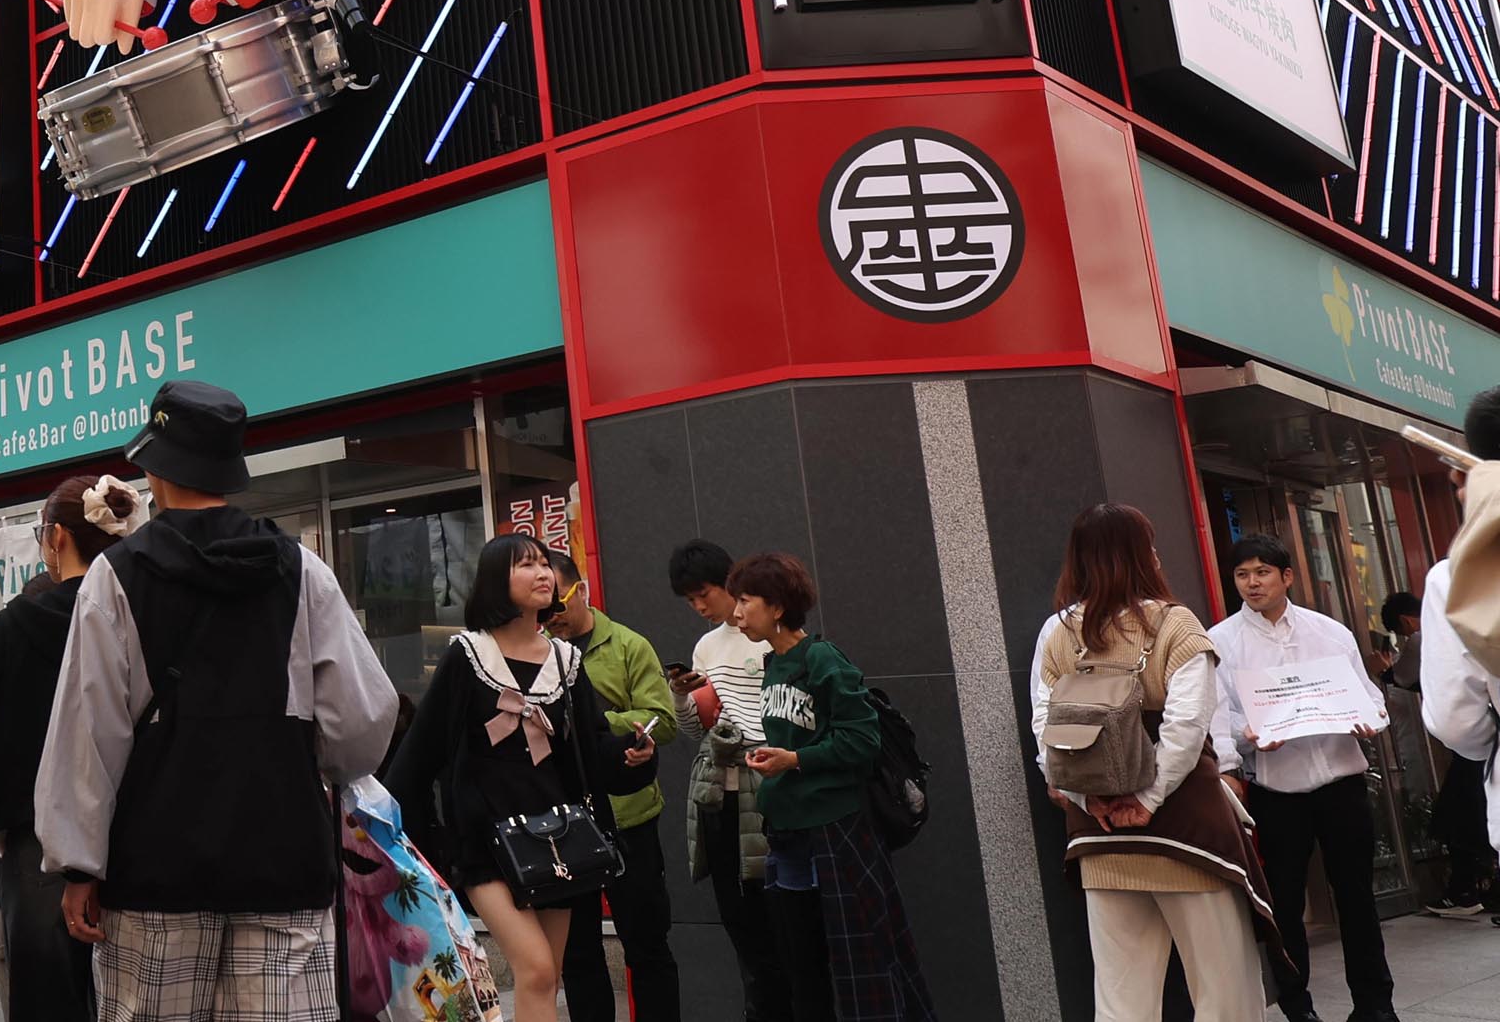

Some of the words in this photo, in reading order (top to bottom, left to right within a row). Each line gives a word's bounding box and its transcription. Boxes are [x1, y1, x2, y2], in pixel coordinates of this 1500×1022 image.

[87, 310, 197, 396] BASE
[1352, 282, 1409, 356] Pivot
[1405, 308, 1456, 376] BASE
